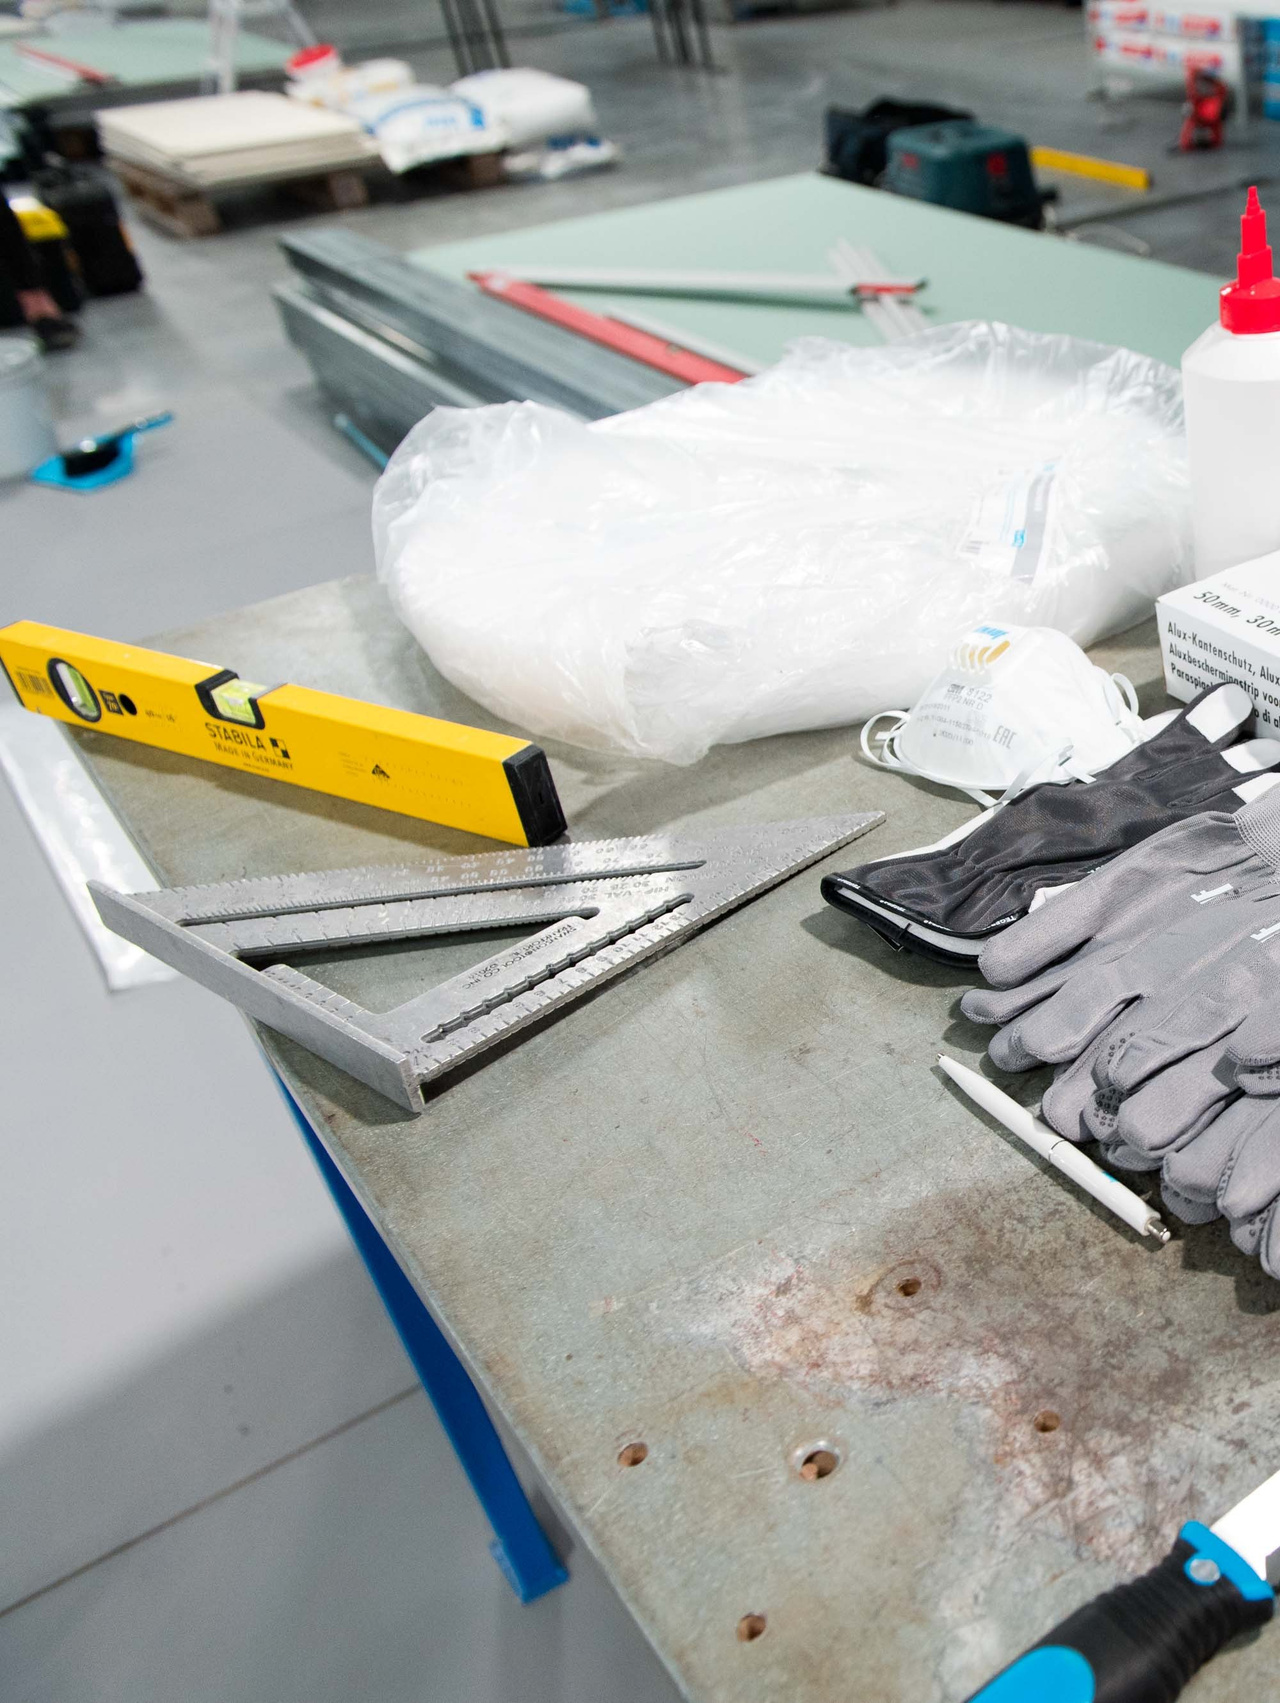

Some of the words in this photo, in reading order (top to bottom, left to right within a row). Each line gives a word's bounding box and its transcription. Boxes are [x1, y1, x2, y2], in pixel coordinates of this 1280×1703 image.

[1193, 591, 1241, 618] 50mm,
[1167, 621, 1256, 677] Alux-Kantenschutz,
[205, 722, 268, 751] STABILA
[214, 741, 240, 757] MADE
[239, 748, 252, 761] IN
[252, 751, 294, 771] GERMANY
